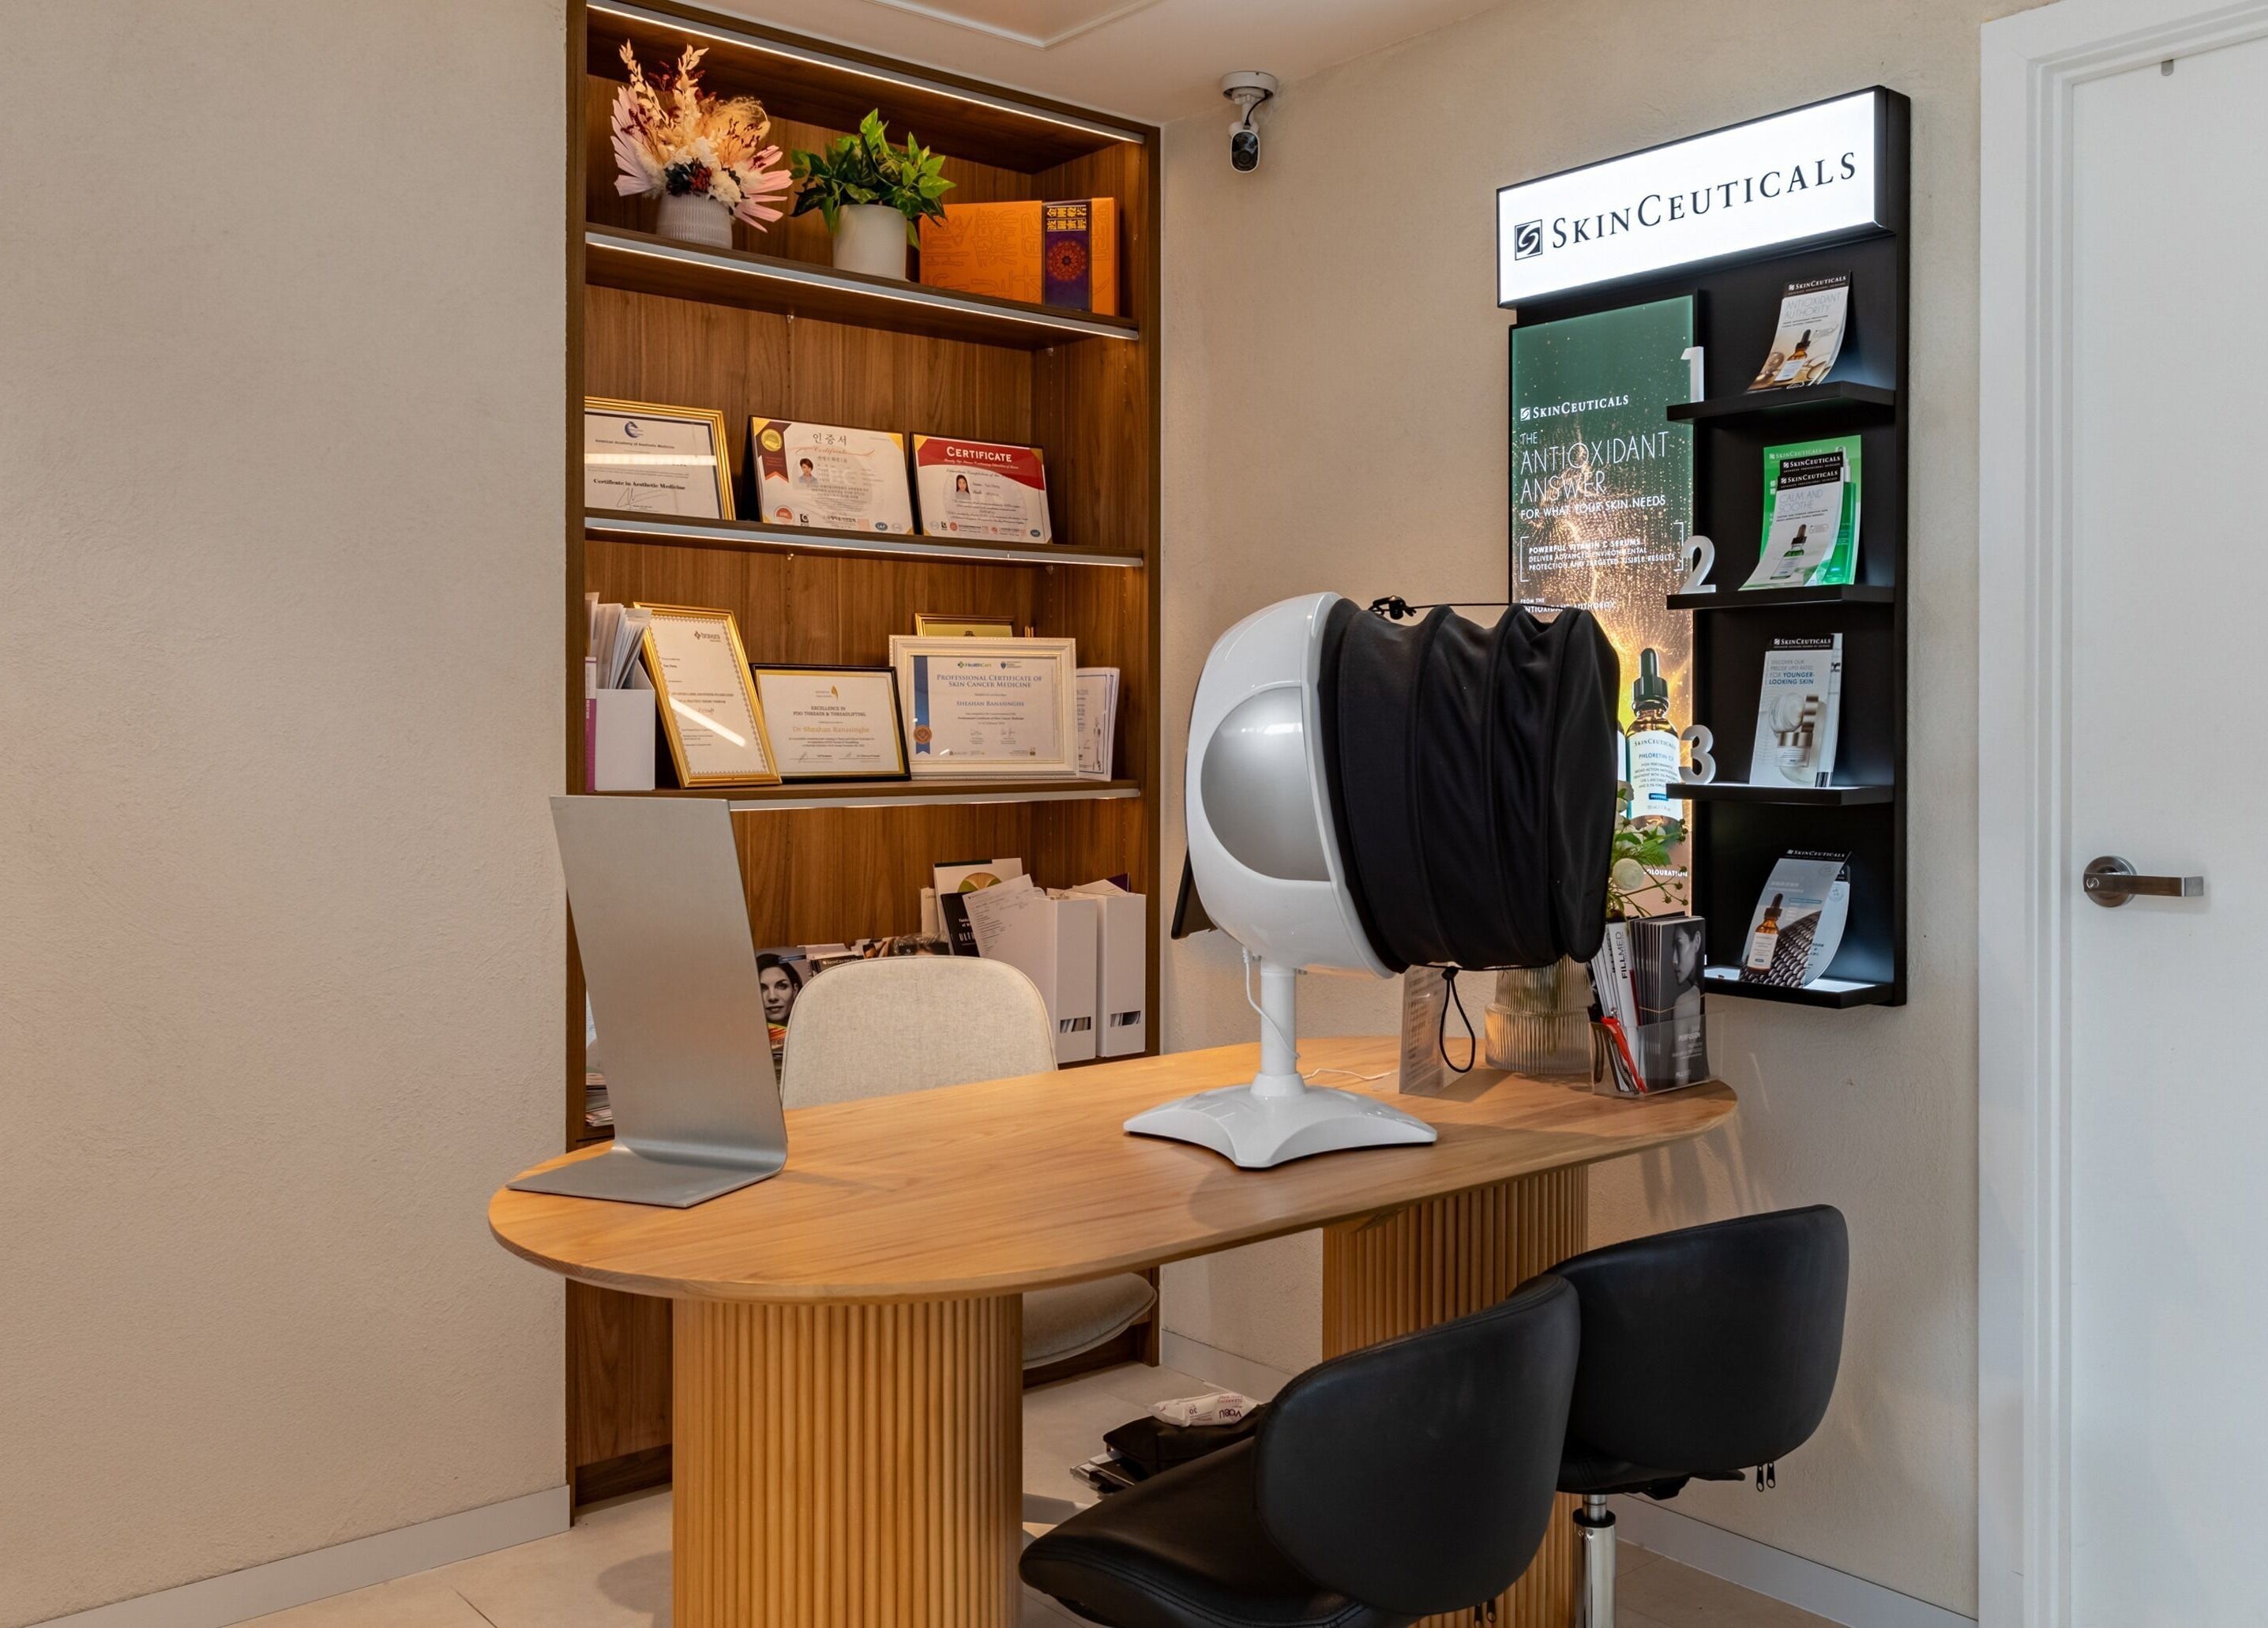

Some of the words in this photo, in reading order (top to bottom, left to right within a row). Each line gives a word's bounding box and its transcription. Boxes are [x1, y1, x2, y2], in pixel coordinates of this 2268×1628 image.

[1553, 152, 1856, 248] SKINCEUTICALS
[1796, 276, 1846, 289] SKINCEUTICALS
[1533, 395, 1630, 419] SKINCEUTICALS
[1520, 432, 1538, 445] THE
[947, 446, 1012, 463] CERTIFICATE
[1521, 431, 1669, 475] ANTIOXIDANT
[1790, 456, 1841, 468] SKINCEUTICALS
[1788, 471, 1838, 483] SKINCEUTICALS
[1521, 471, 1605, 504] ANSWER
[1521, 509, 1539, 520] FOR
[1544, 506, 1570, 517] WHAT
[1605, 500, 1628, 511] SKIN
[1632, 495, 1665, 508] NEEDS
[1529, 545, 1566, 554] POWERFUL
[1570, 541, 1600, 551] VITAMIN
[1647, 553, 1676, 562] RESULTS
